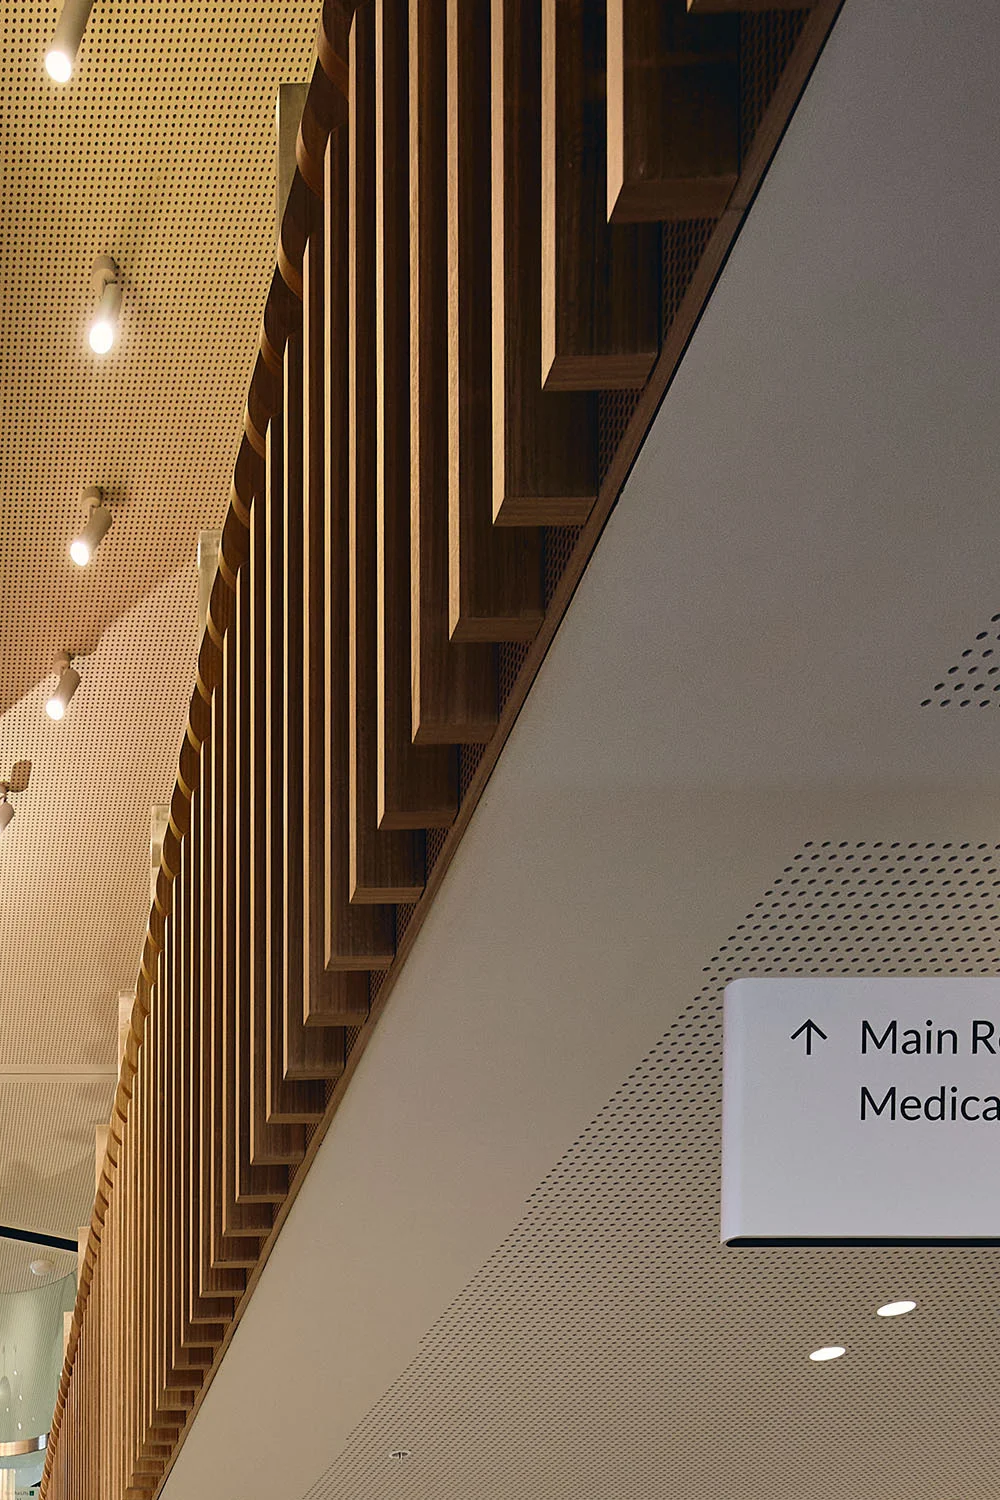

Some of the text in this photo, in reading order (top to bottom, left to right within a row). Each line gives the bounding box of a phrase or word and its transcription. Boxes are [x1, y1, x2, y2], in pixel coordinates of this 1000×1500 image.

[862, 1020, 1000, 1055] Main R
[861, 1086, 1000, 1121] Medica
